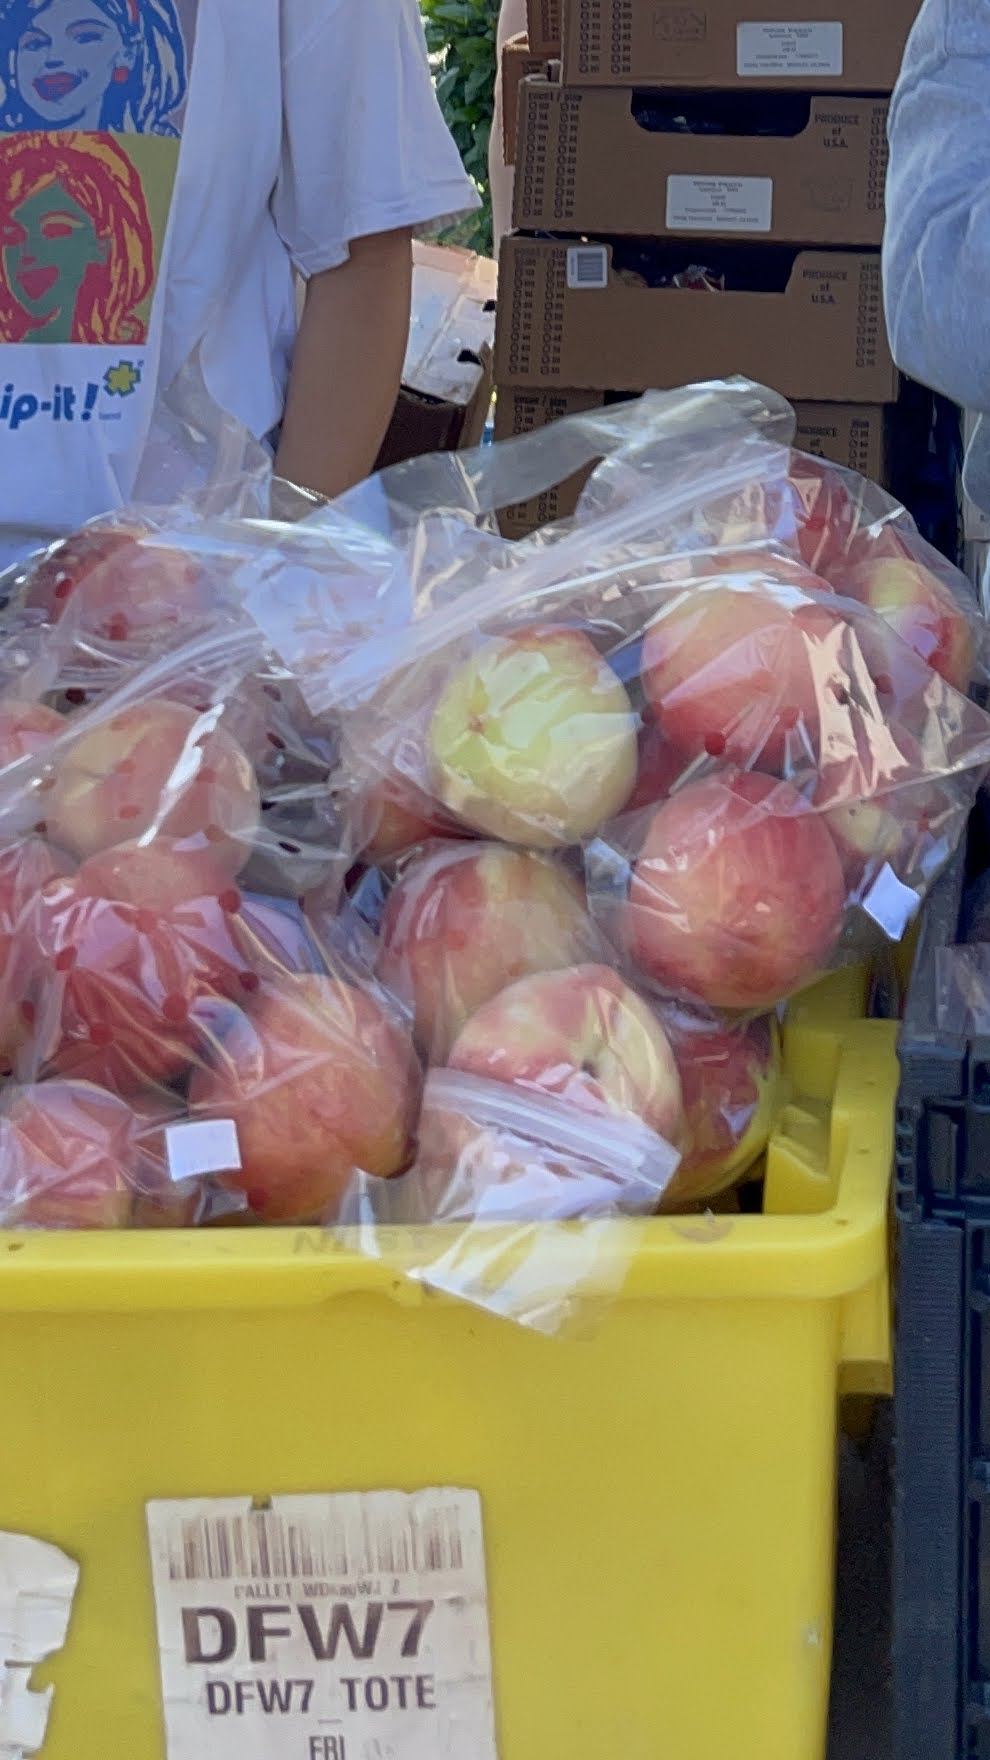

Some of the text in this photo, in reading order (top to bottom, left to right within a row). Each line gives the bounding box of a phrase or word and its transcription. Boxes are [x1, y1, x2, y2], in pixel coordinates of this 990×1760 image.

[814, 113, 859, 125] PRODUCE
[832, 127, 841, 136] of
[802, 270, 848, 281] PRODUCE
[820, 282, 830, 291] of
[181, 1600, 434, 1664] DFW7
[206, 1674, 436, 1715] DFW7 TOTE
[309, 1735, 345, 1760] FRI
